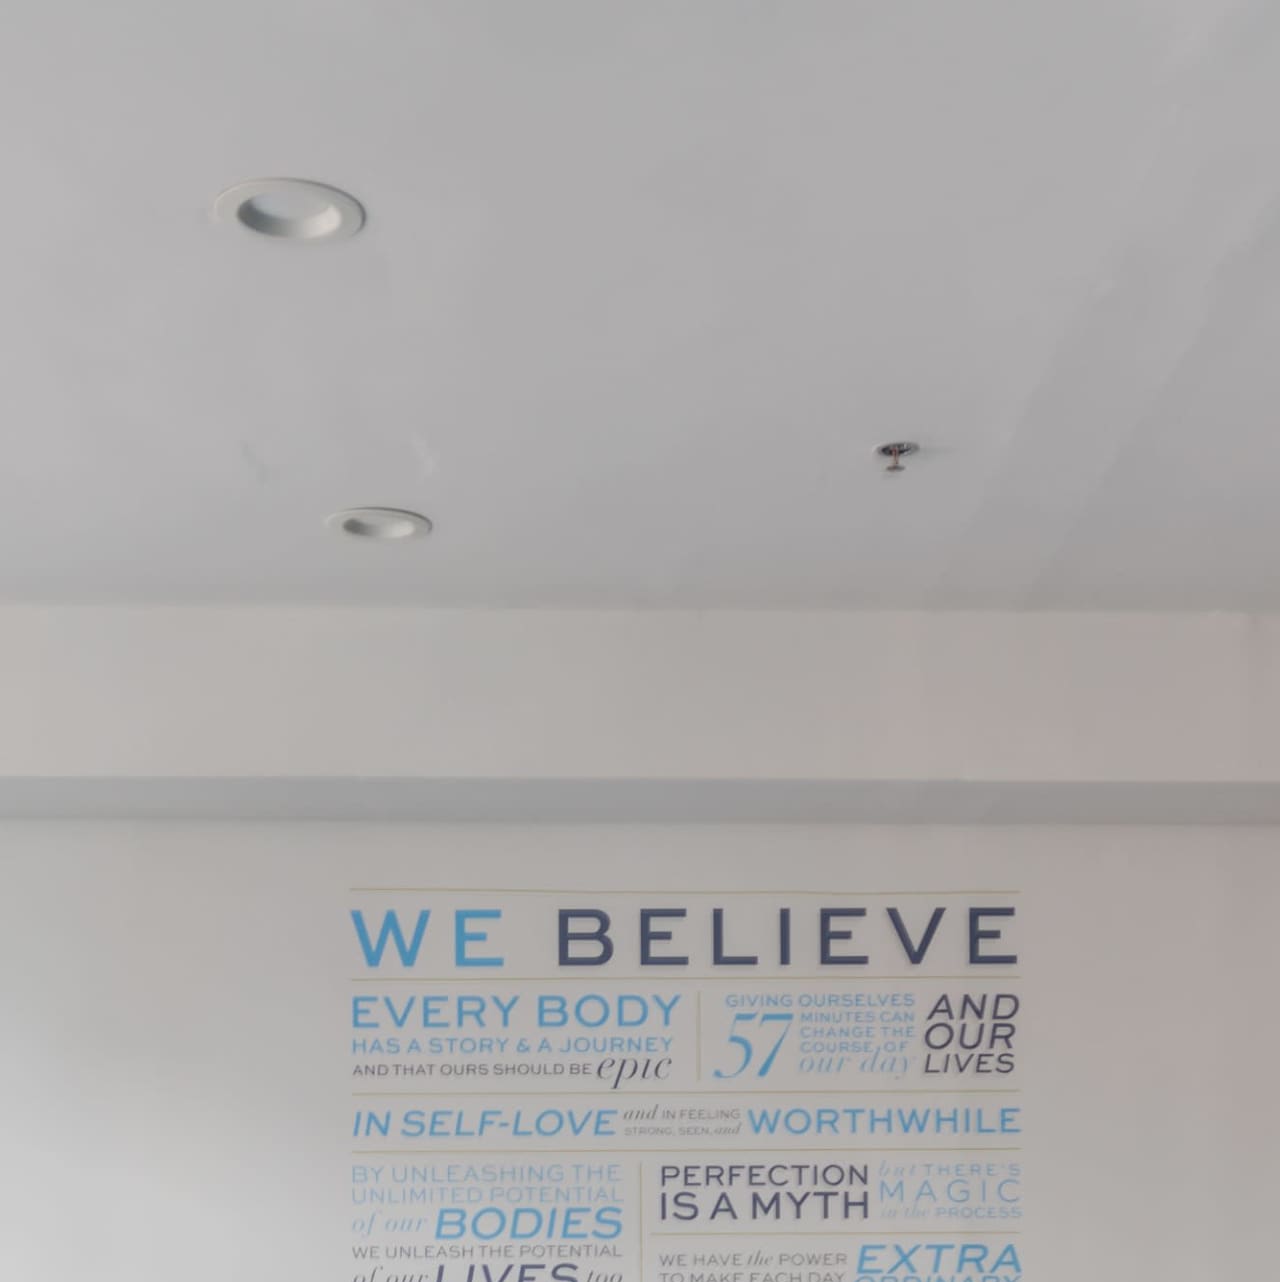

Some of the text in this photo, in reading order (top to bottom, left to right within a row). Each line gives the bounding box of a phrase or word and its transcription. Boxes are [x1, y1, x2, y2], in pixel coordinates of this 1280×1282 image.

[349, 907, 1018, 968] WE BELIEVE
[351, 994, 682, 1029] EVERY BODY
[725, 994, 916, 1008] GIVING OURSELVES
[925, 994, 1020, 1021] AND
[799, 1011, 915, 1024] MINUTES CAN
[799, 1025, 916, 1039] CHANGE THE
[923, 1022, 1016, 1050] OUR
[351, 1036, 675, 1055] HAS A STORY & A JOURNEY
[712, 1012, 794, 1079] 57
[799, 1040, 909, 1054] COURSE OF
[352, 1056, 673, 1090] AND THAT OURS SHOULD BE epic
[798, 1047, 916, 1080] our day
[923, 1053, 1016, 1074] LIVES
[352, 1109, 618, 1138] IN SELF-LOVE
[622, 1103, 741, 1121] and IN FEELING
[746, 1107, 1021, 1136] WORTHWHILE
[351, 1163, 622, 1184] BY UNLEASHING THE
[660, 1164, 869, 1187] PERFECTION
[351, 1186, 625, 1204] UNLIMITED POTENTIAL
[879, 1179, 1020, 1204] MAGIC
[659, 1191, 870, 1221] IS A MYTH
[936, 1206, 1023, 1219] PROCESS
[351, 1206, 624, 1241] of our BODIES
[351, 1244, 624, 1260] WE UNLEASH THE POTENTIAL
[659, 1249, 848, 1268] WE HAVE the POWER
[856, 1244, 1023, 1275] EXTRA
